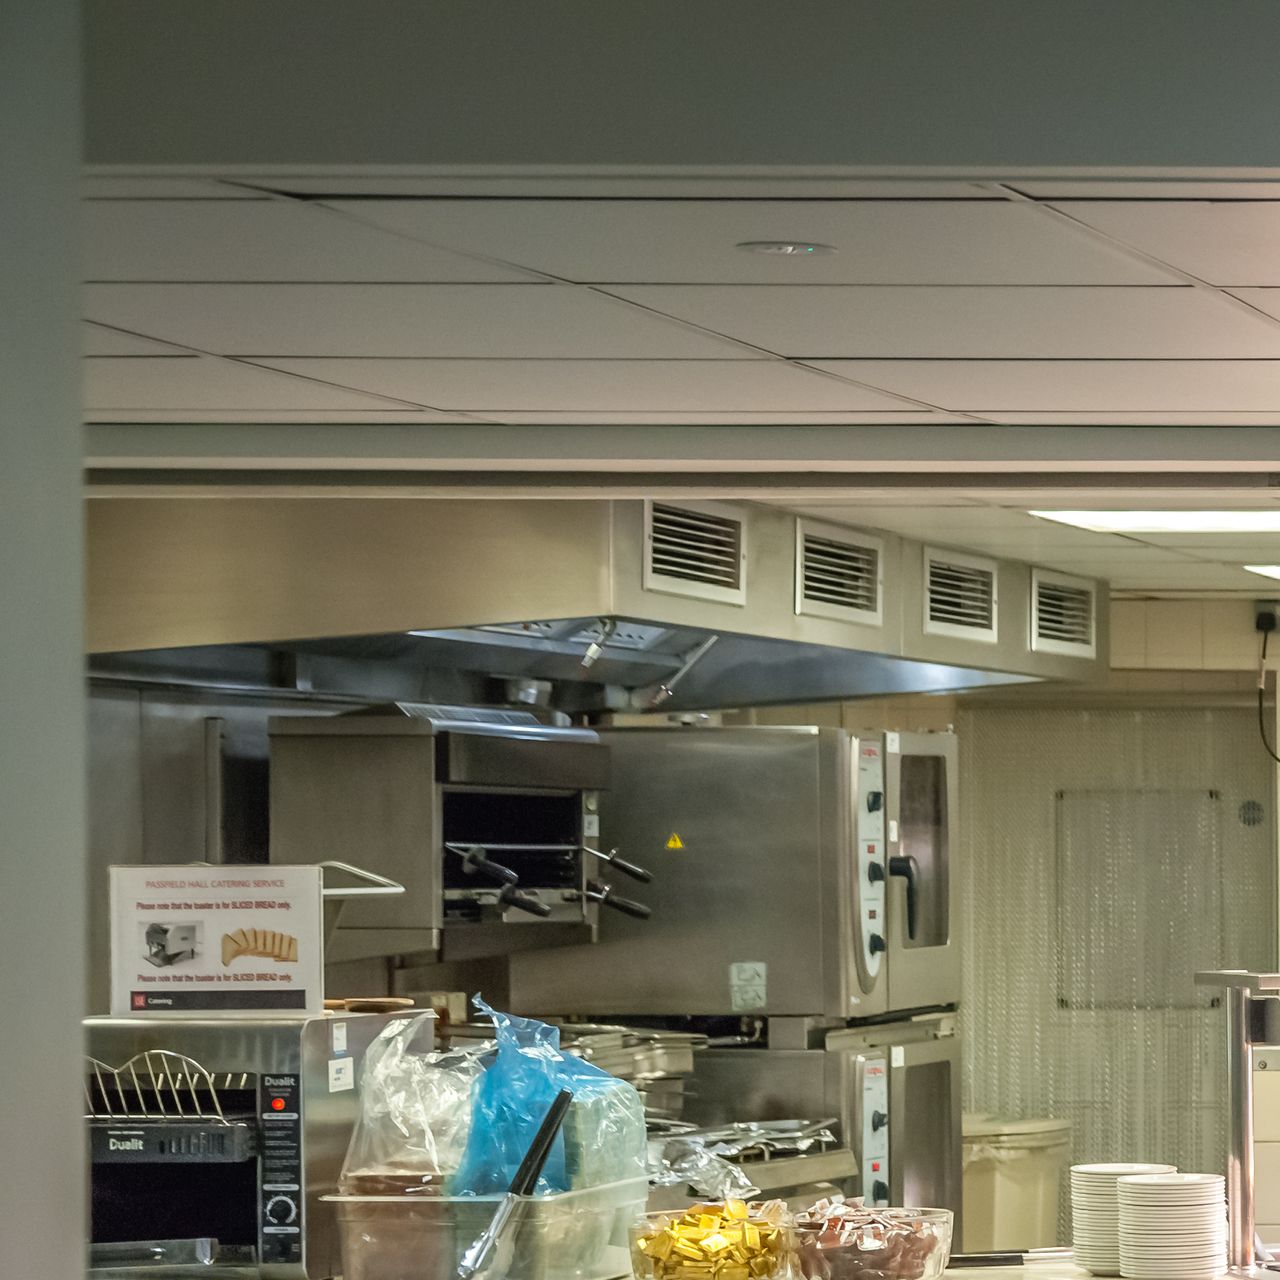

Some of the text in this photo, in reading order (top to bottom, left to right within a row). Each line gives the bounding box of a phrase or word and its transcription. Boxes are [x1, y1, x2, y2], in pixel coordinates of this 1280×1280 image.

[211, 880, 251, 888] CATERING
[136, 902, 155, 910] Please
[157, 902, 170, 910] note
[171, 902, 182, 910] that
[184, 902, 192, 910] the
[194, 902, 214, 910] toaster
[215, 902, 220, 910] is
[231, 901, 253, 909] SLICED
[255, 901, 276, 909] BREAD
[137, 974, 156, 982] Please
[158, 974, 170, 982] note
[172, 974, 183, 982] that
[185, 974, 194, 982] the
[195, 974, 215, 982] toaster
[216, 974, 221, 982] is
[223, 974, 231, 982] for
[233, 973, 255, 981] SLICED
[256, 973, 277, 981] BREAD
[265, 1076, 296, 1086] Dualit
[109, 1138, 144, 1150] Dualit
